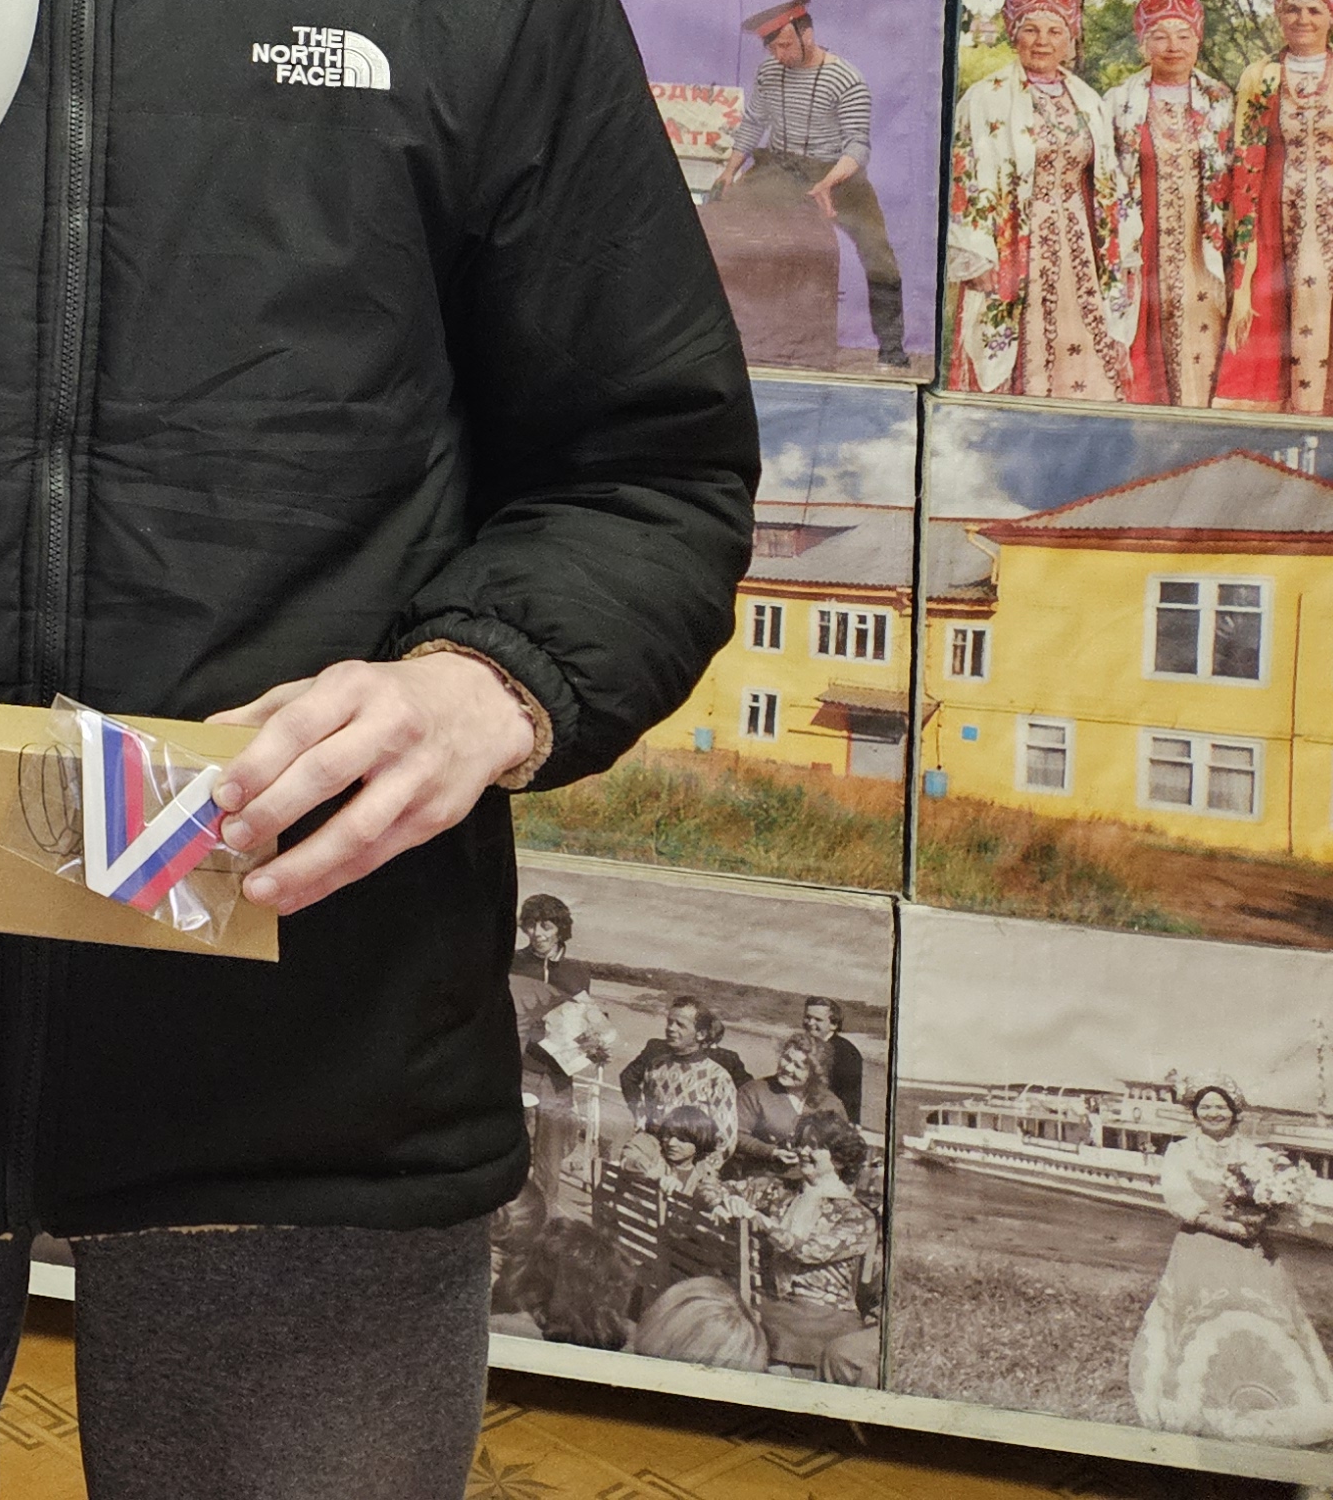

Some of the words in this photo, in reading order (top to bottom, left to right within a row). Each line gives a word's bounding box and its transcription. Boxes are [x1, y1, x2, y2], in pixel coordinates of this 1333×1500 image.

[292, 26, 343, 48] THE
[252, 43, 342, 68] NORTH
[276, 63, 342, 87] FACE
